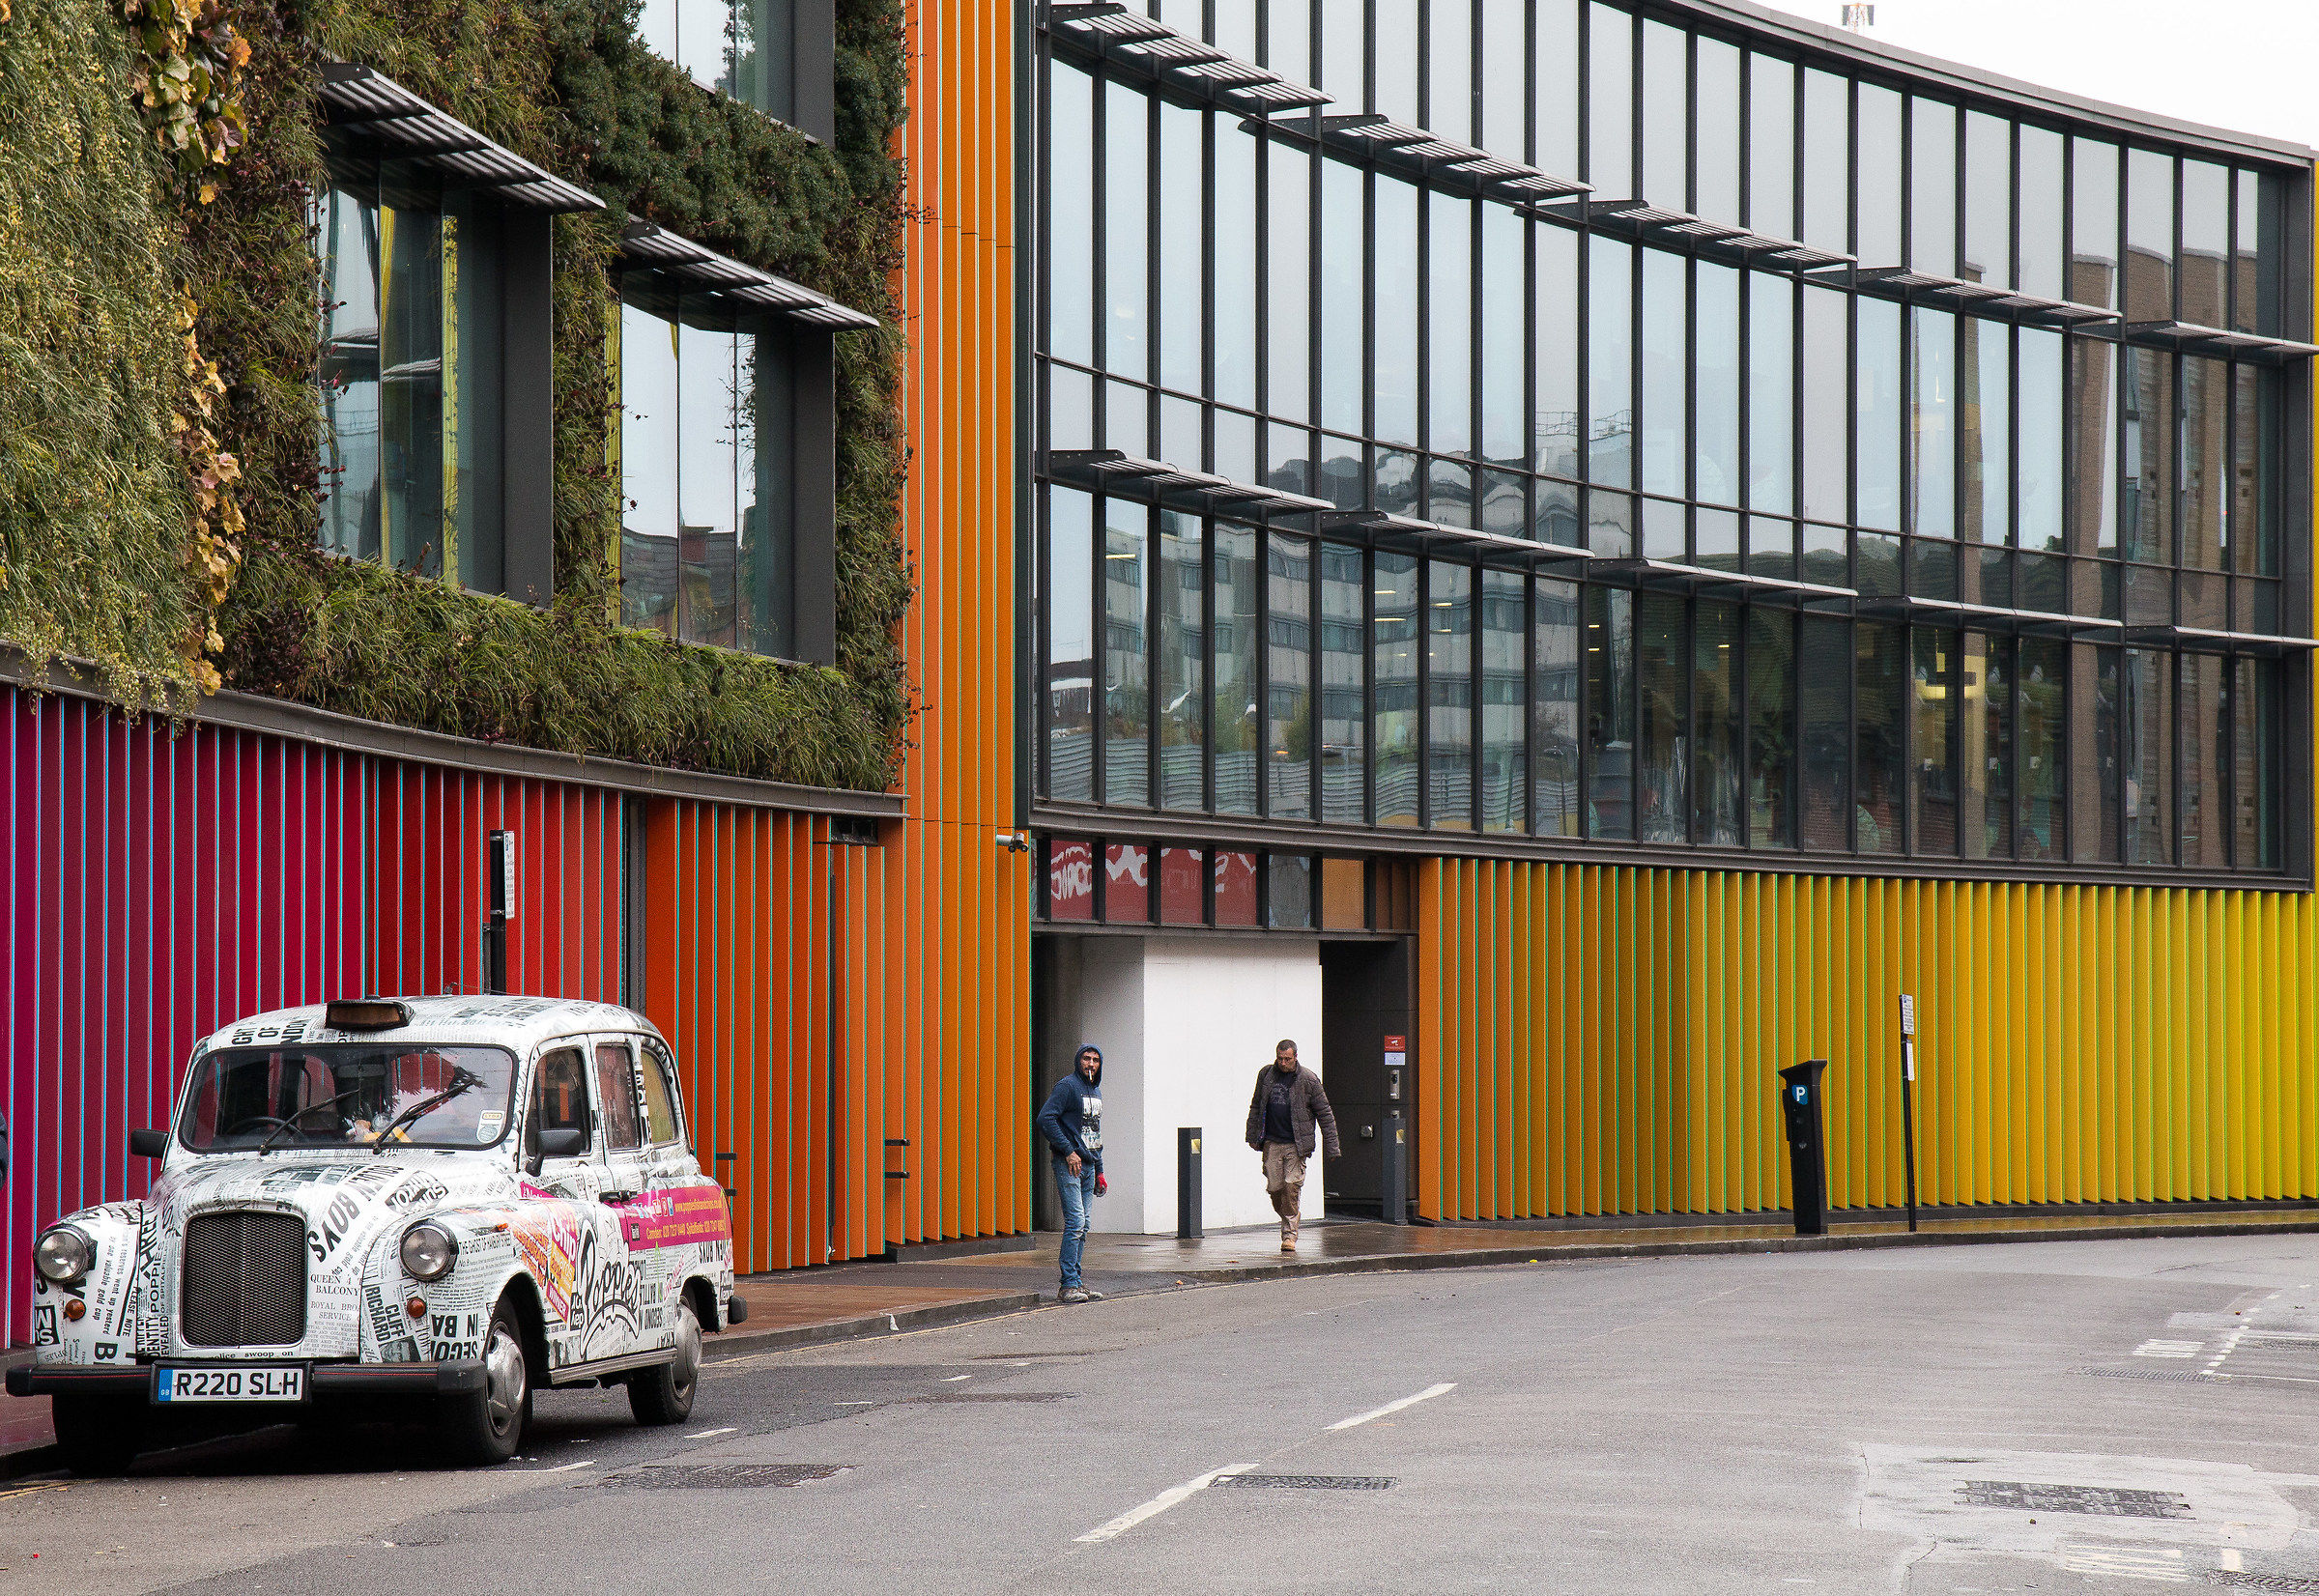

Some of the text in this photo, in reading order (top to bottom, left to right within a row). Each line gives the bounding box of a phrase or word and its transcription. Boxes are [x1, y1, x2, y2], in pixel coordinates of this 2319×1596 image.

[257, 1027, 281, 1039] OF
[1795, 1087, 1806, 1101] P
[307, 1191, 360, 1263] BOYS
[150, 1240, 165, 1313] POPPIES
[310, 1273, 341, 1285] QUEEN
[331, 1266, 343, 1278] cup
[111, 1277, 122, 1296] went
[315, 1284, 360, 1297] BALCONY
[97, 1289, 106, 1305] gold
[108, 1295, 117, 1306] up
[123, 1286, 137, 1338] PLEASE NOTE
[310, 1301, 336, 1310] ROYAL
[92, 1307, 101, 1321] cup
[319, 1311, 352, 1322] SERVICE
[364, 1286, 392, 1343] RICHARD
[385, 1303, 406, 1338] CLIFF
[431, 1313, 478, 1337] IN BA
[160, 1316, 170, 1356] EVEALED
[176, 1372, 300, 1396] R220 SLH
